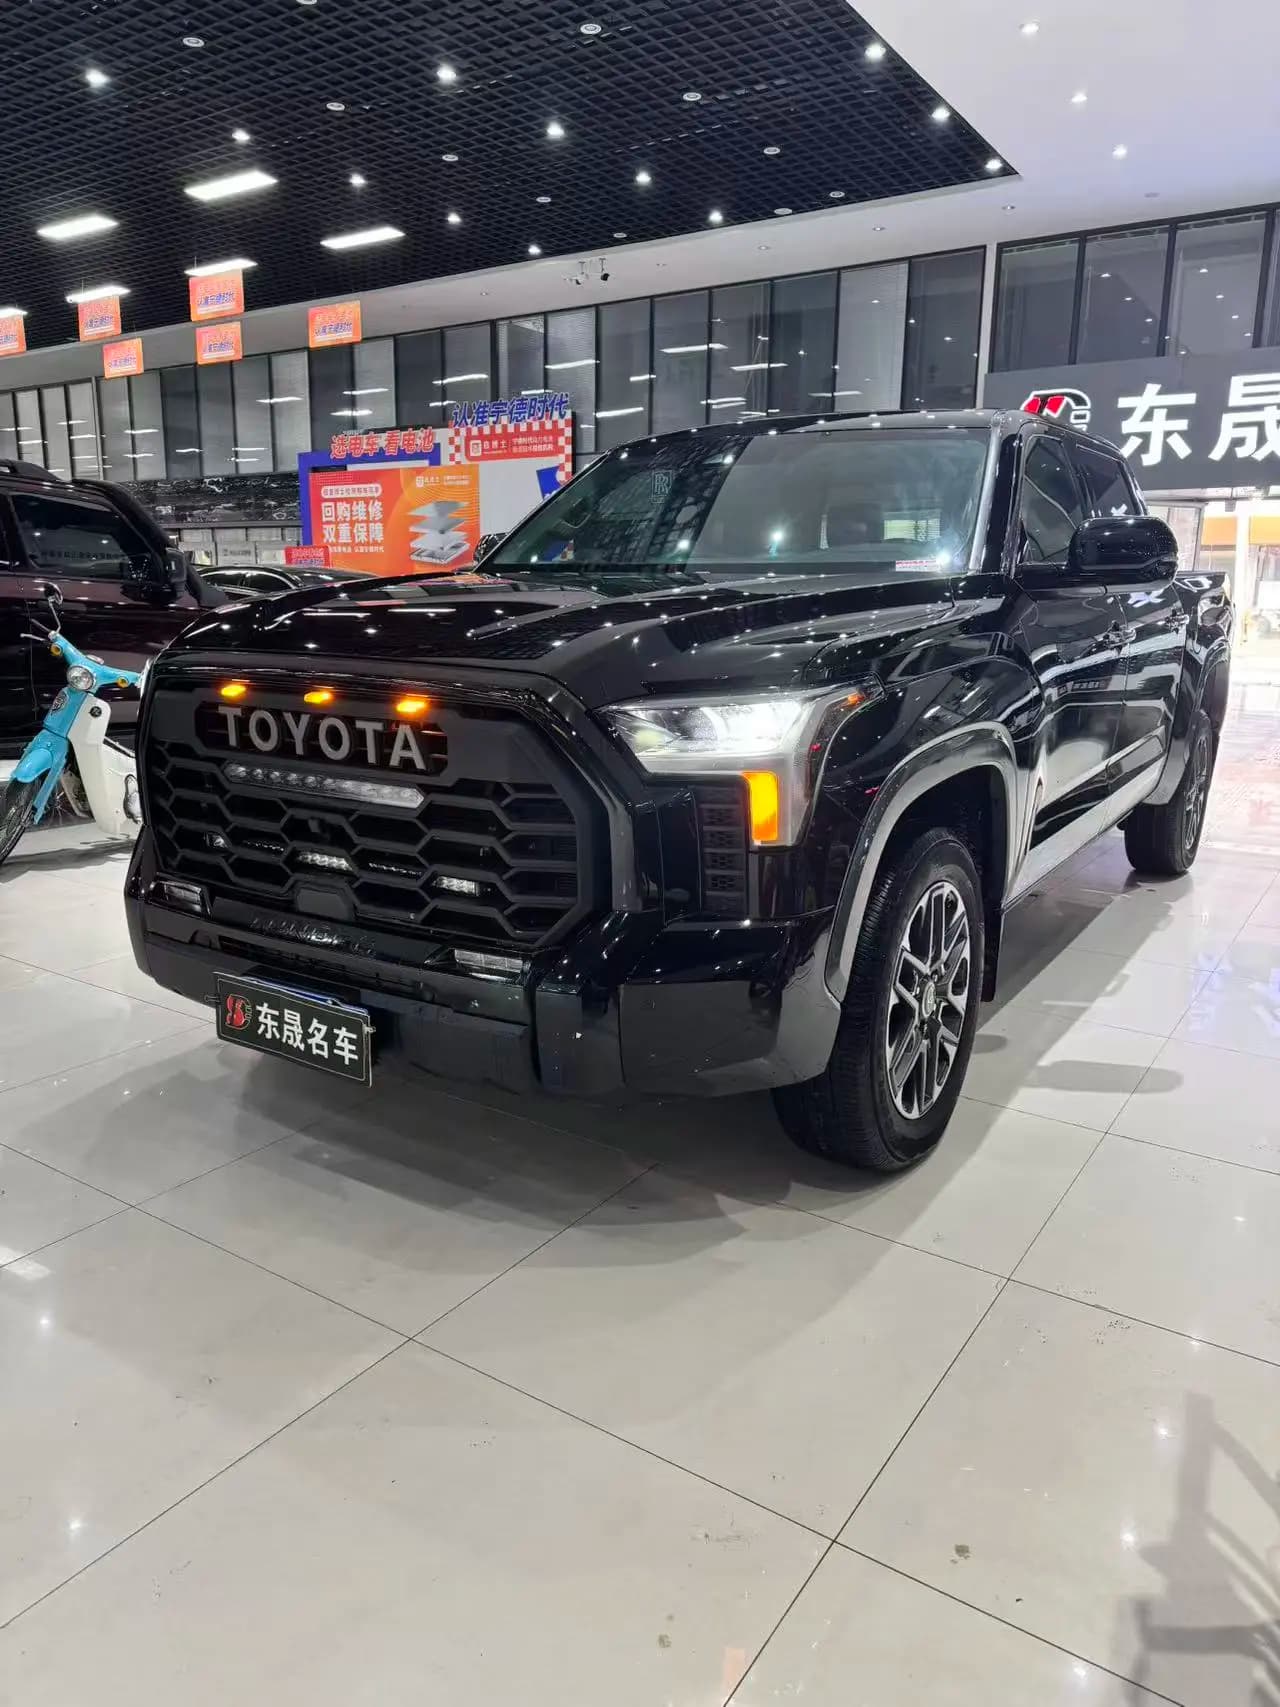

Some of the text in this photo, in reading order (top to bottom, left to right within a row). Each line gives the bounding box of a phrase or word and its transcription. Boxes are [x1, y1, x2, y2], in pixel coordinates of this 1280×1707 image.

[453, 393, 569, 427] 认准宁德时代
[1118, 372, 1280, 466] 东晟
[330, 427, 434, 459] 选电车 看电池
[321, 500, 384, 522] 回购维修
[322, 523, 384, 544] 双重保障
[217, 705, 427, 771] TOYOTA
[256, 1002, 358, 1065] 东晟名车
